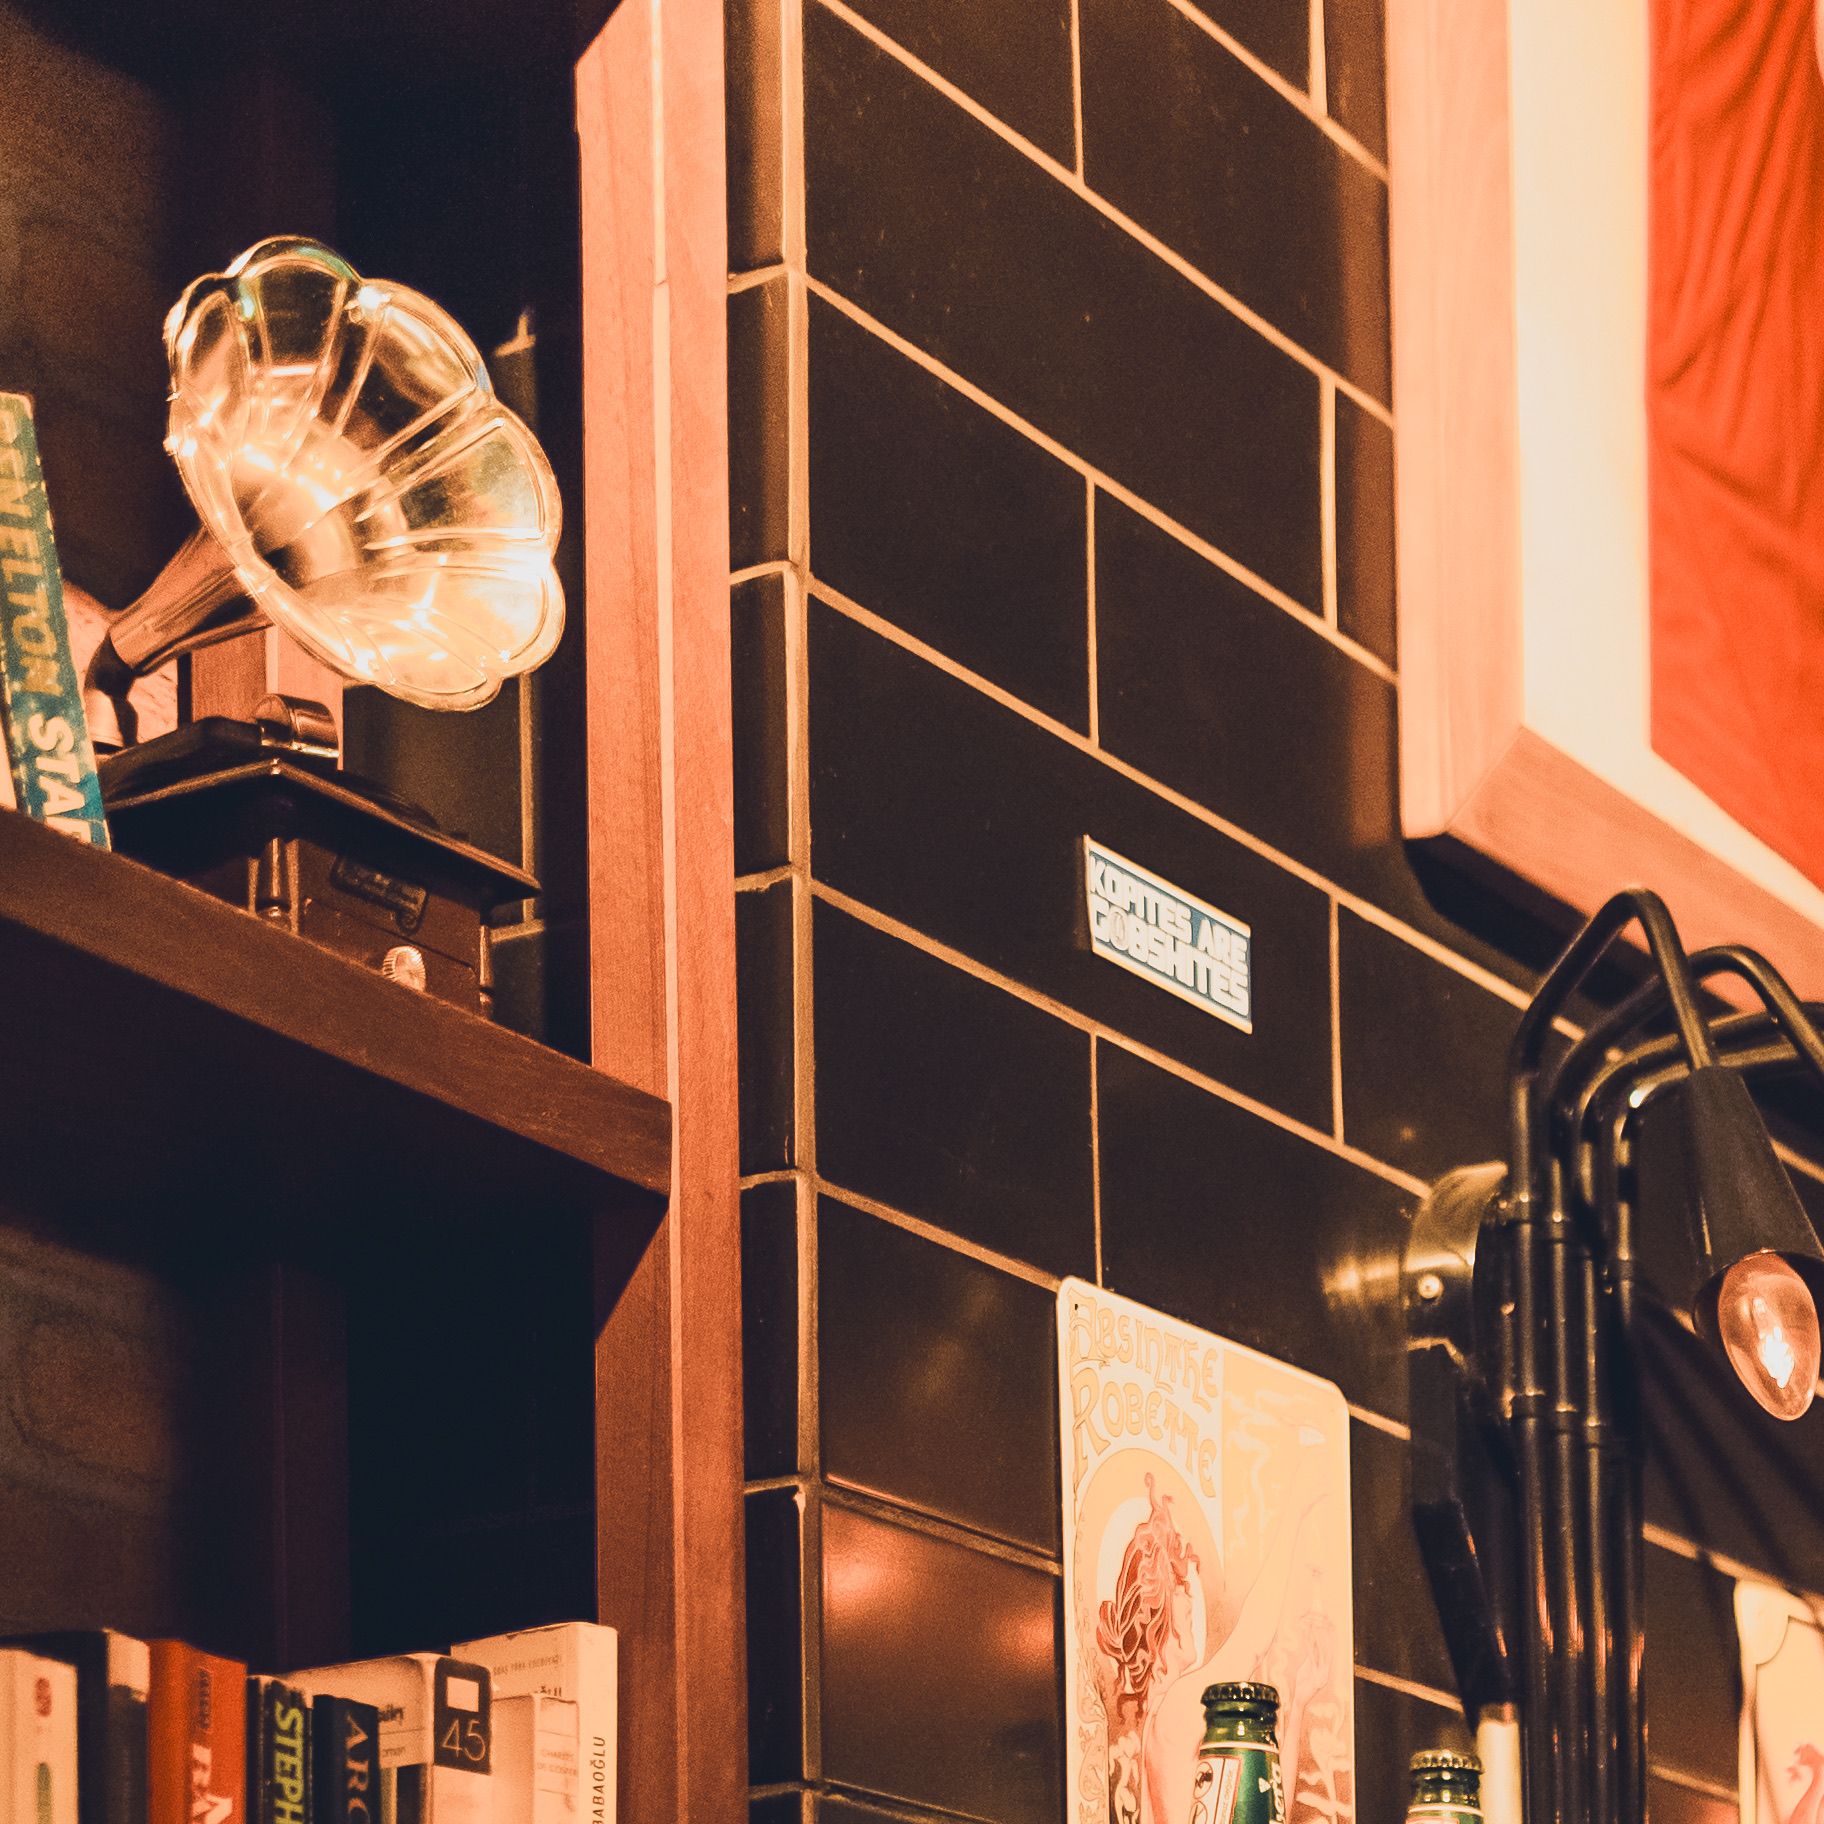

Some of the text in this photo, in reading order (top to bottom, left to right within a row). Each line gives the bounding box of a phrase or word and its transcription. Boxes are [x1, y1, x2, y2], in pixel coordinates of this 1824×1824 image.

[0, 523, 63, 699] ELTON
[1197, 915, 1250, 972] ARE
[1069, 1290, 1223, 1408] ABSINTHE
[1070, 1366, 1220, 1497] ROBETTE
[442, 1718, 486, 1761] 45
